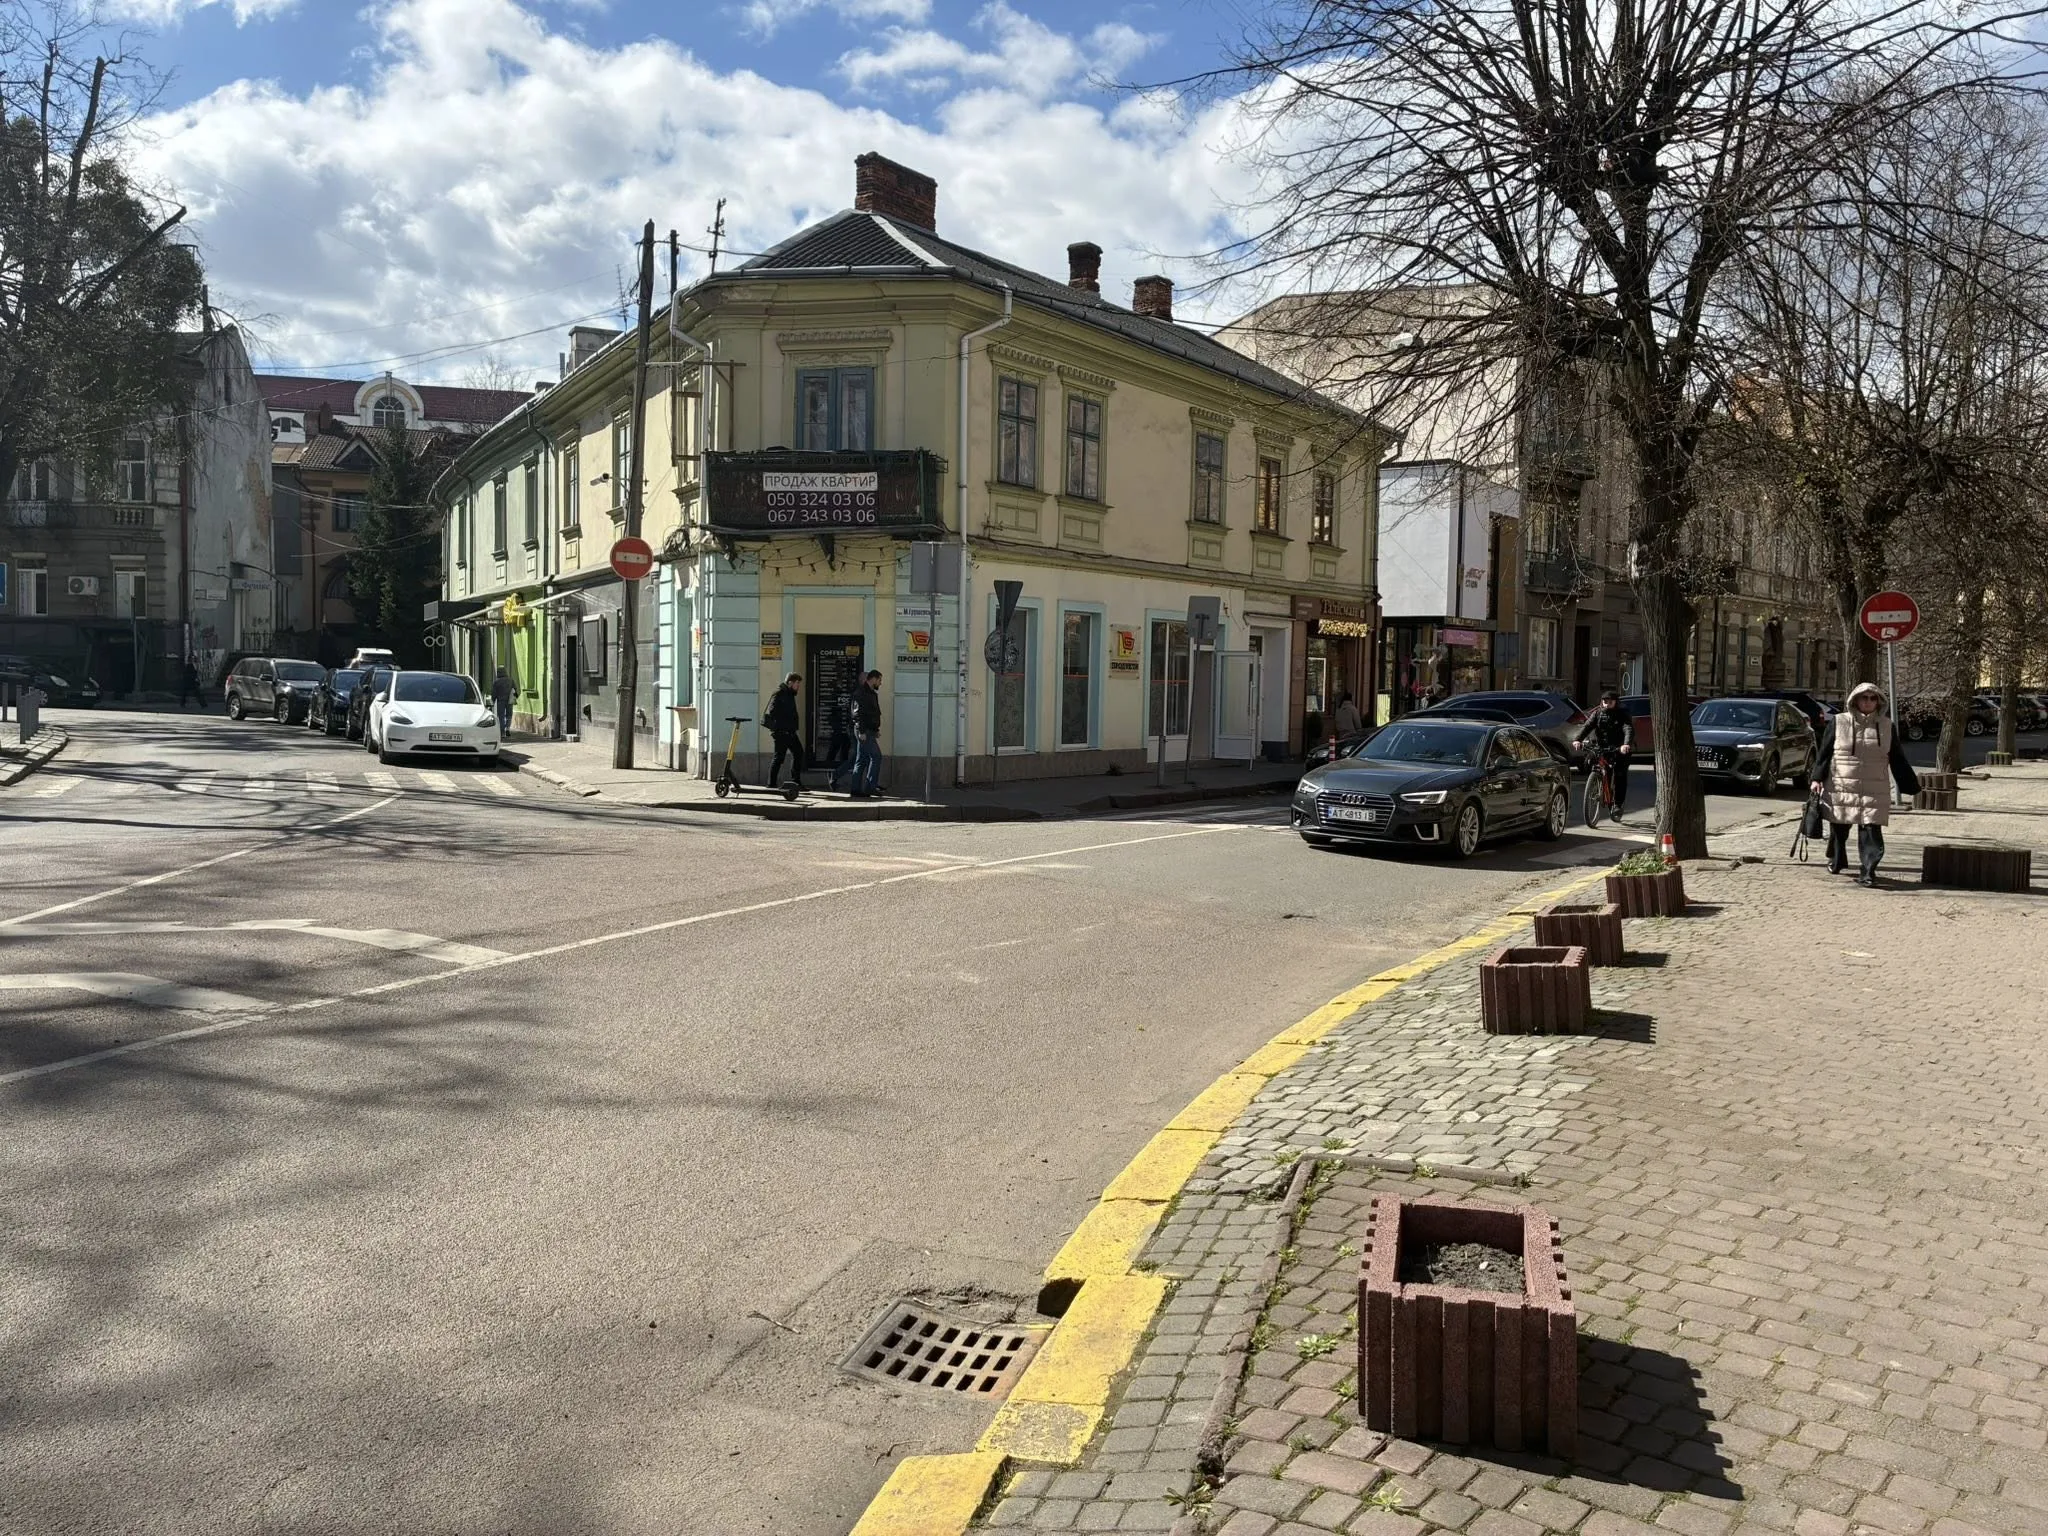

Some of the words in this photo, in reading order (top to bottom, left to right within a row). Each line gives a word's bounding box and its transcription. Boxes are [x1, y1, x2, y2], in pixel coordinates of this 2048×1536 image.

[764, 475, 818, 489] ПРОДАЖ
[821, 474, 876, 487] КВАРТИР
[767, 493, 795, 506] 050
[800, 493, 827, 506] 324
[832, 493, 851, 506] 03
[856, 492, 875, 506] 06
[768, 510, 795, 523] 067
[800, 510, 828, 522] 343
[832, 510, 851, 522] 03
[856, 510, 876, 523] 06
[1333, 809, 1343, 817] AT
